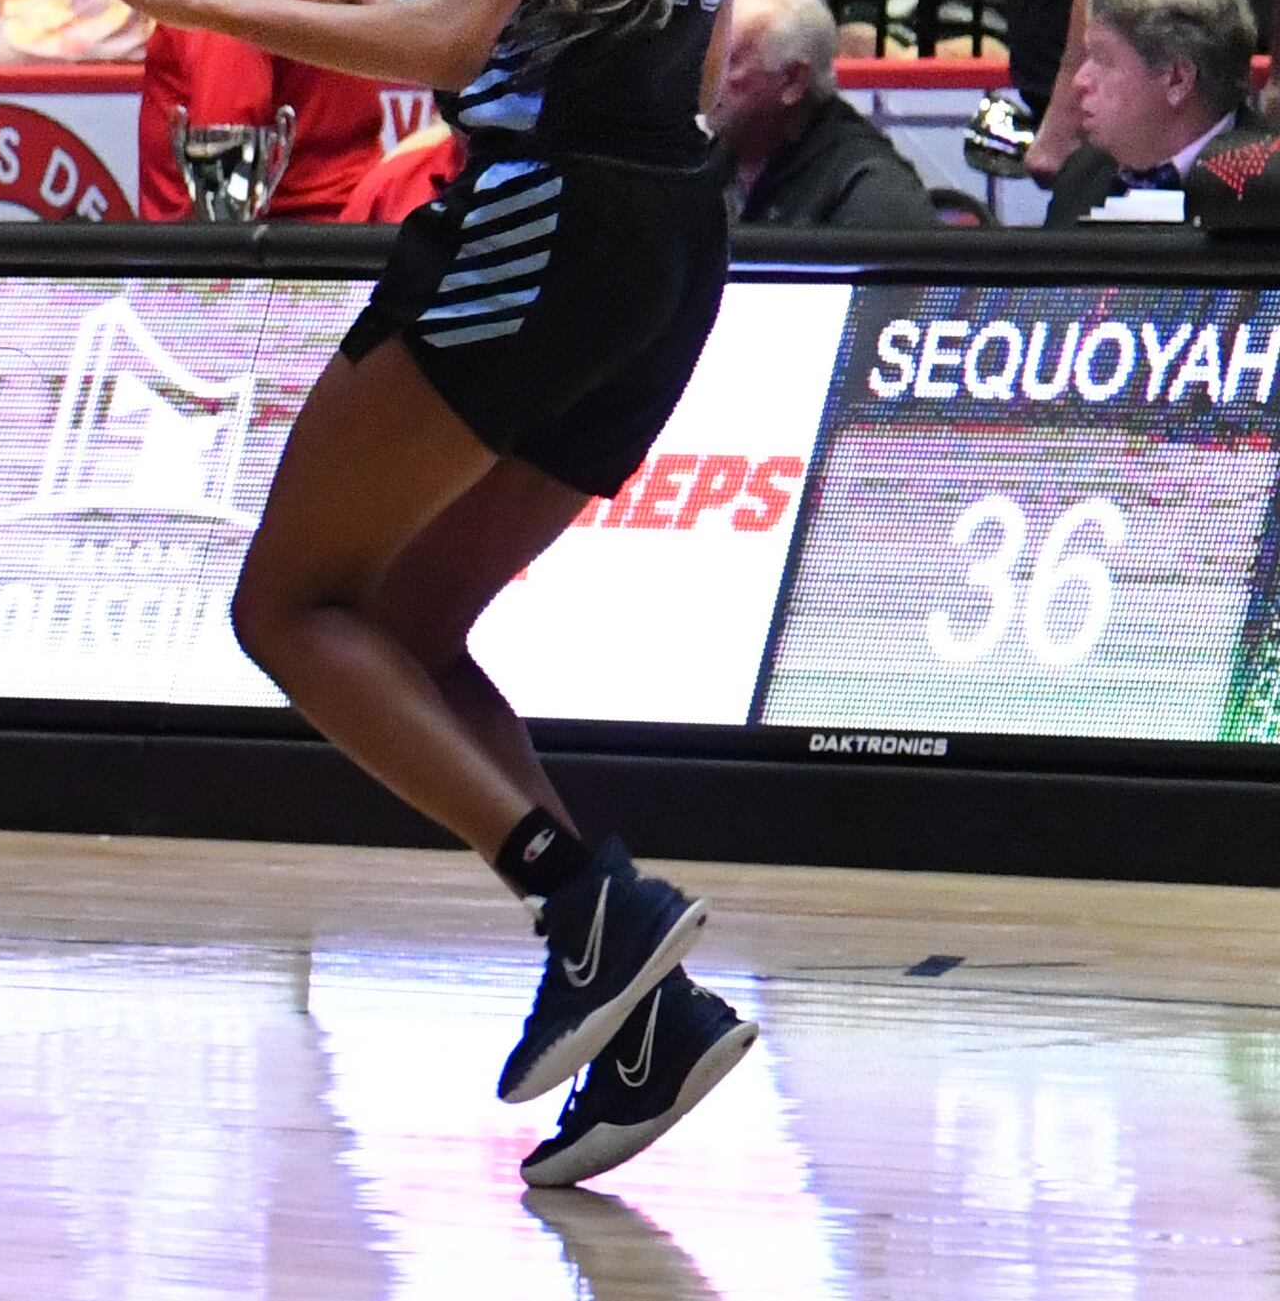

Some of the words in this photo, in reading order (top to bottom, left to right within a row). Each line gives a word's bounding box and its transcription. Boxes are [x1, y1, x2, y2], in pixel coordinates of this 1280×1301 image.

[868, 319, 1280, 404] SEQUOYAH
[926, 495, 1126, 666] 36
[809, 733, 949, 756] DAKTRONICS
